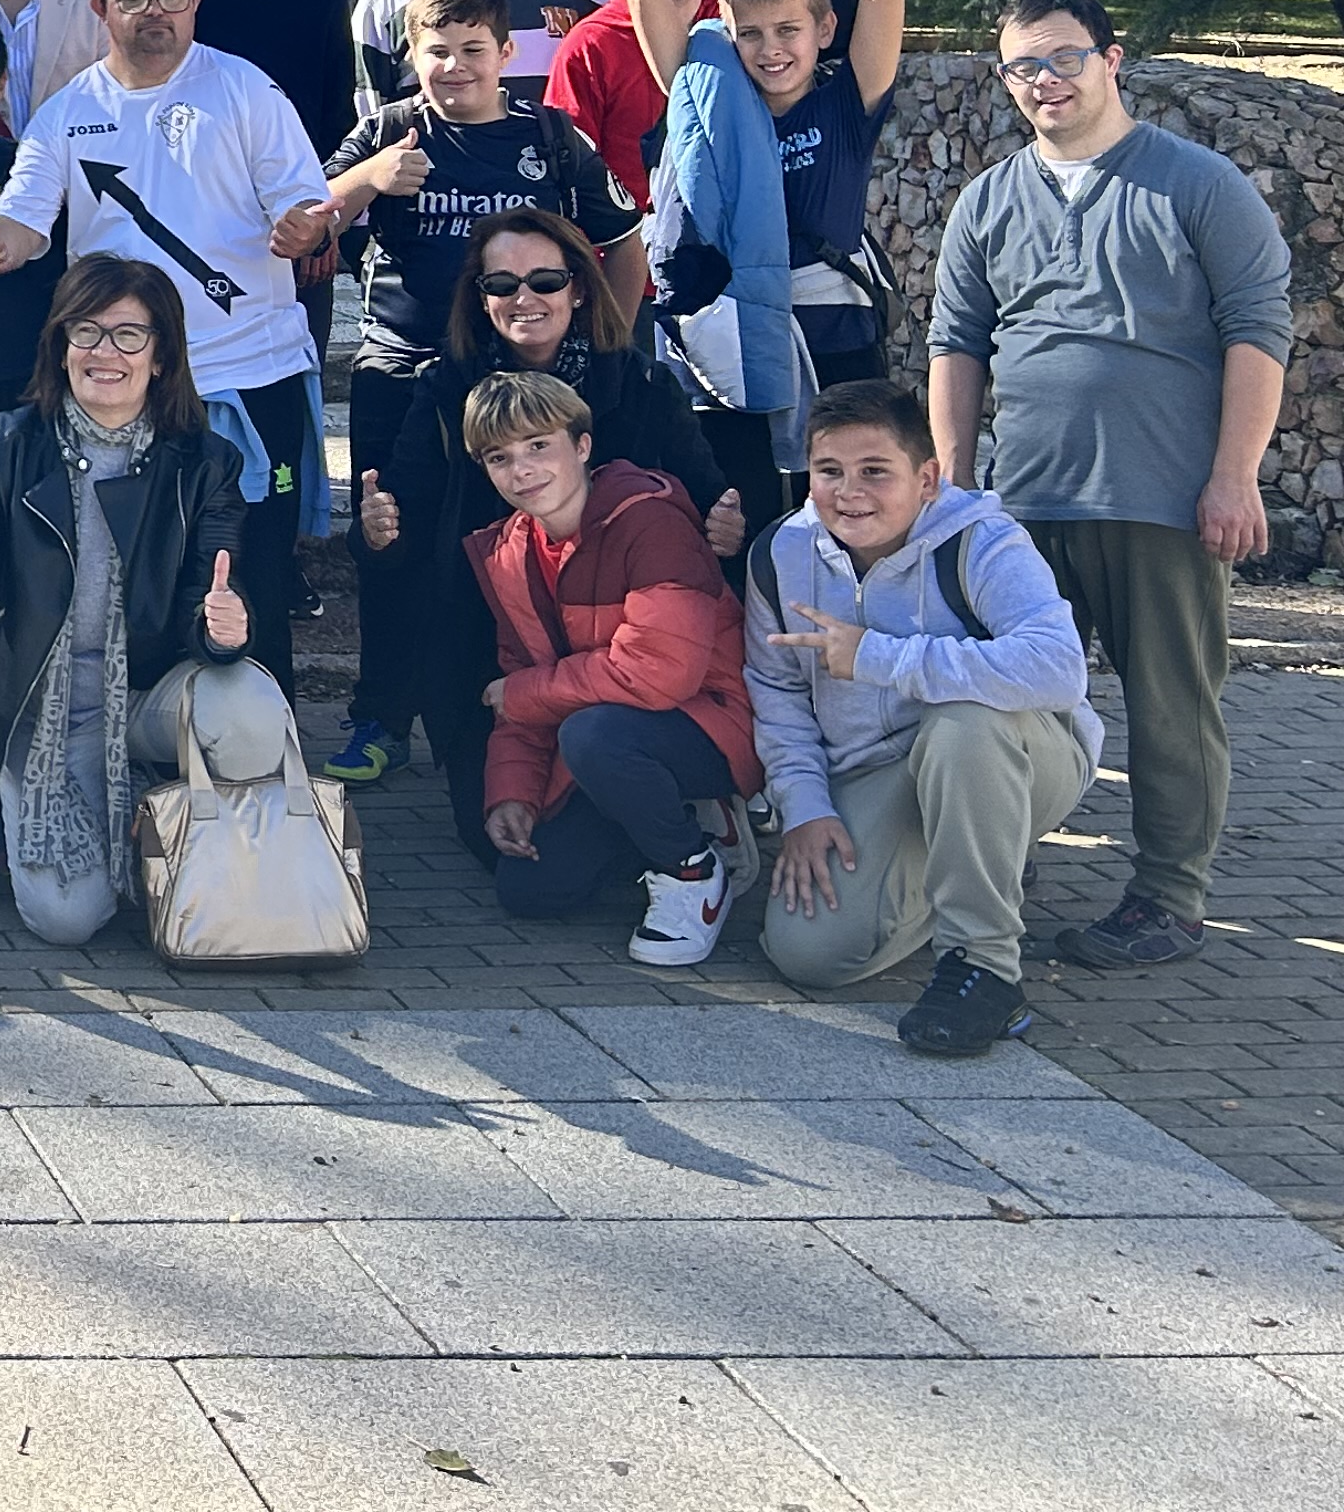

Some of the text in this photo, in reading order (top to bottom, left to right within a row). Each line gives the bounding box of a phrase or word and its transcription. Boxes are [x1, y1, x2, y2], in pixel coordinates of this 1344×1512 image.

[407, 187, 538, 215] mirates
[417, 217, 446, 237] FLY
[206, 279, 229, 295] 50
